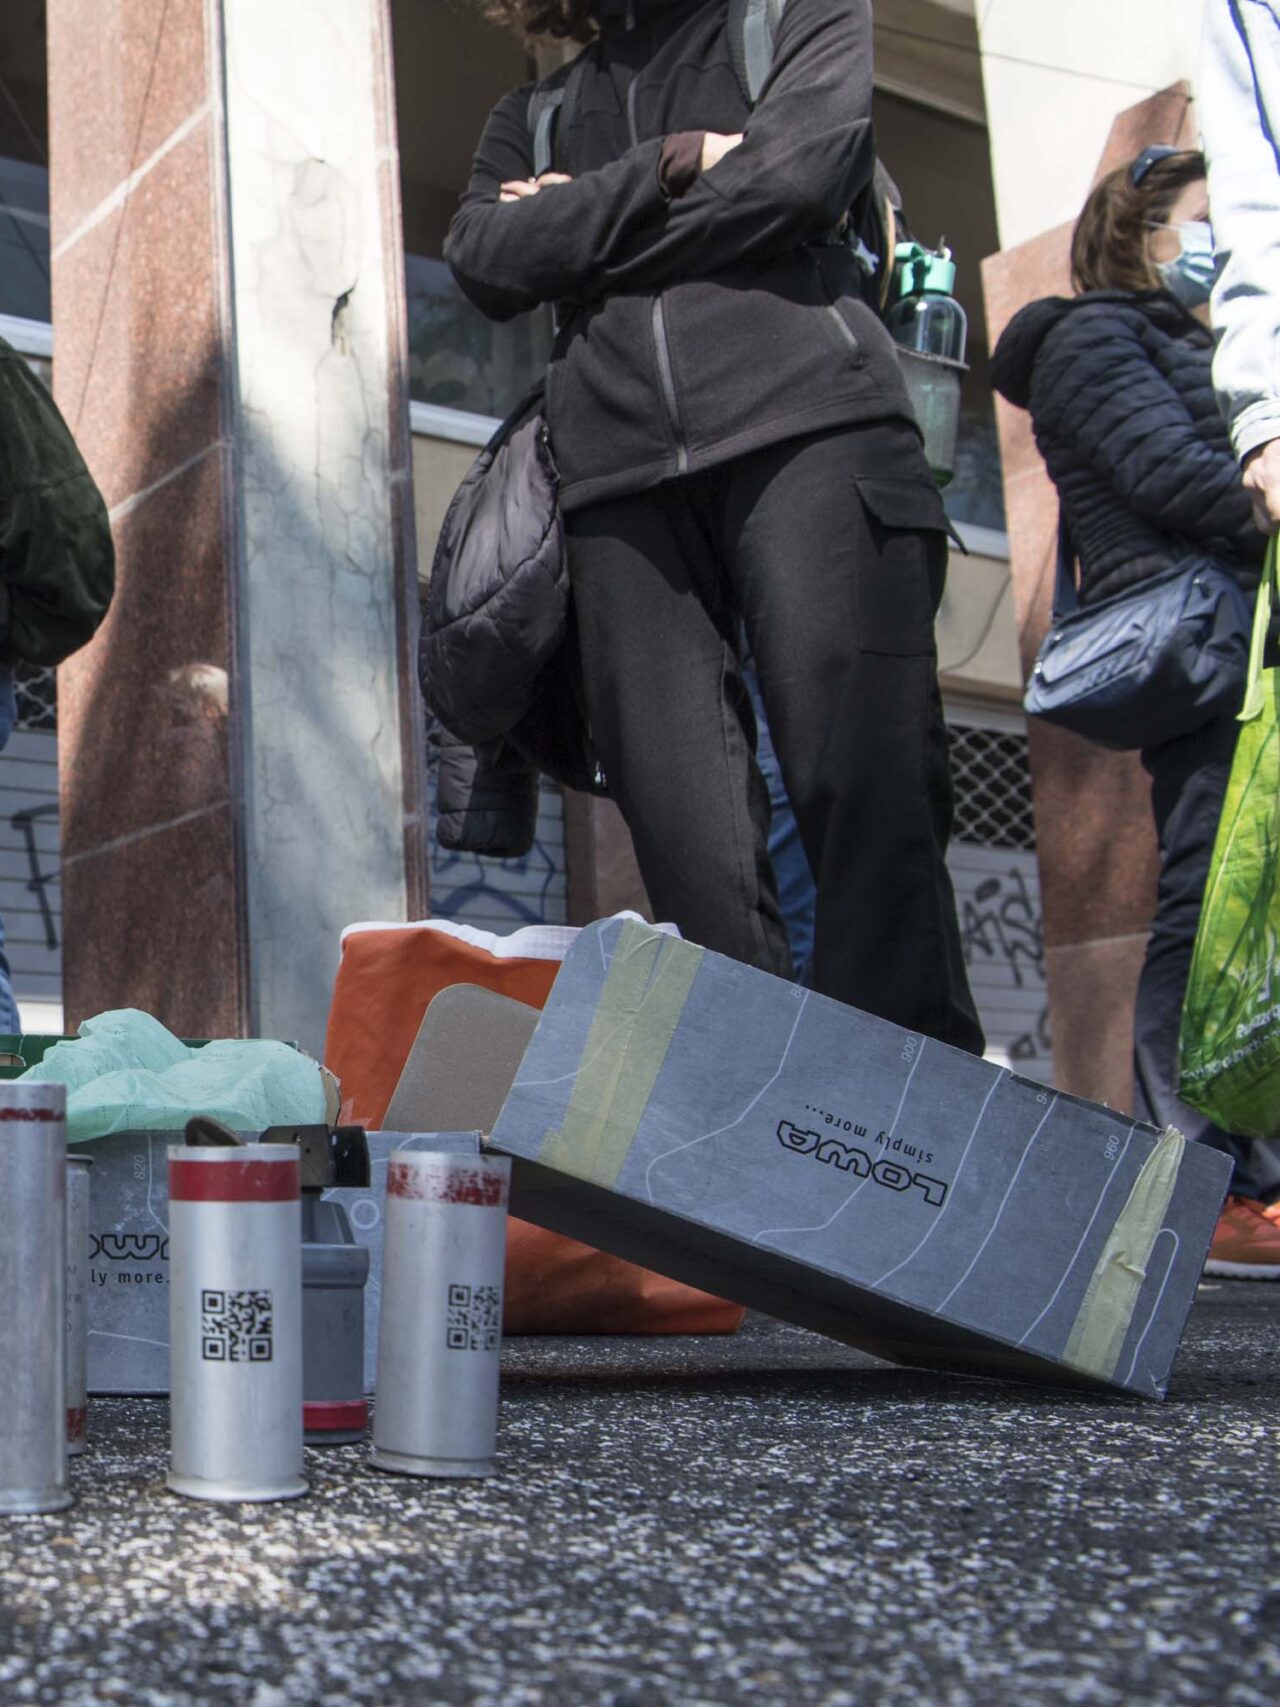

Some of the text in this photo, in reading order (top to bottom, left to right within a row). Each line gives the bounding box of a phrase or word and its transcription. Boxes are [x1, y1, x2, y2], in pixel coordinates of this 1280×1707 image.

[900, 1036, 918, 1063] 900
[875, 1131, 934, 1163] simply
[1103, 1135, 1120, 1161] 960
[134, 1153, 146, 1180] 820
[776, 1119, 949, 1207] LOWA
